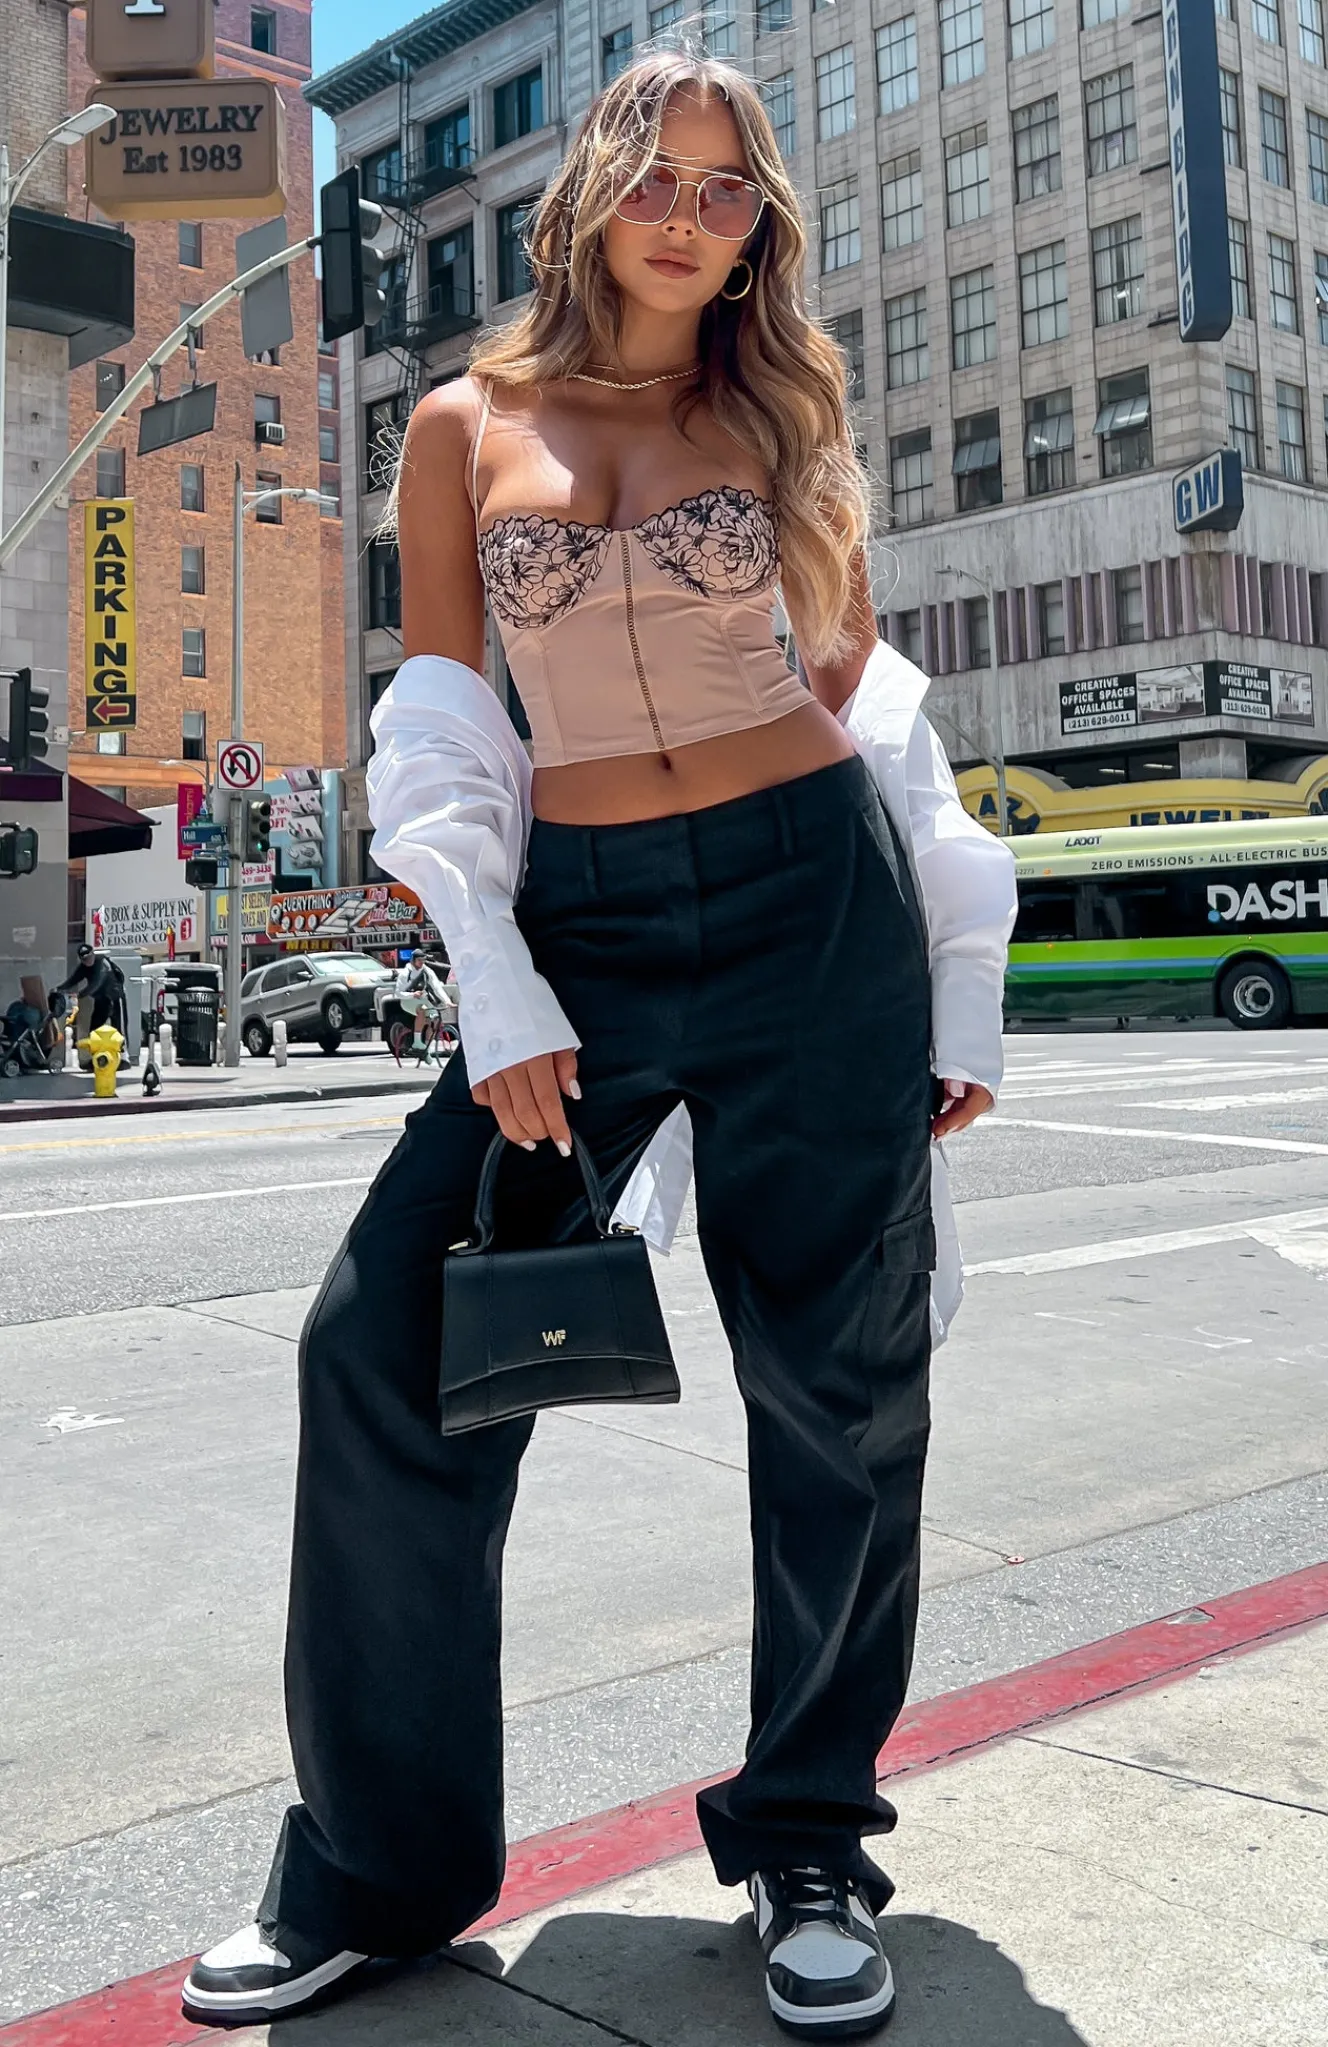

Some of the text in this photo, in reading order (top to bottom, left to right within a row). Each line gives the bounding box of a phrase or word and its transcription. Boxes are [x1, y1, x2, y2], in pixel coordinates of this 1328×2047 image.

[99, 104, 264, 145] JEWELRY
[122, 144, 243, 174] Est 1983
[1173, 126, 1192, 328] BLDG
[1176, 460, 1220, 525] GW
[93, 506, 128, 694] PARKING
[1228, 664, 1258, 678] CREATIVE
[1074, 677, 1119, 692] CREATIVE
[1220, 674, 1269, 691] OFFICE SPACES
[1061, 686, 1135, 705] OFFICE SPACES
[1228, 688, 1262, 701] AVAILABLE
[1074, 699, 1124, 715] AVAILABLE
[1068, 713, 1131, 729] (213) 629-0011
[1064, 835, 1102, 848] LADOT
[1091, 846, 1328, 870] ZERO EMISSIONS ALL-ELECTRIC BUS
[283, 893, 332, 912] EVERYTHING
[1207, 878, 1328, 922] DASH
[111, 905, 130, 922] BOX
[132, 903, 139, 920] &
[141, 900, 177, 919] SUPPLY
[108, 933, 149, 946] EDSBOX
[356, 931, 384, 945] SMOKE
[385, 930, 407, 944] SHOP
